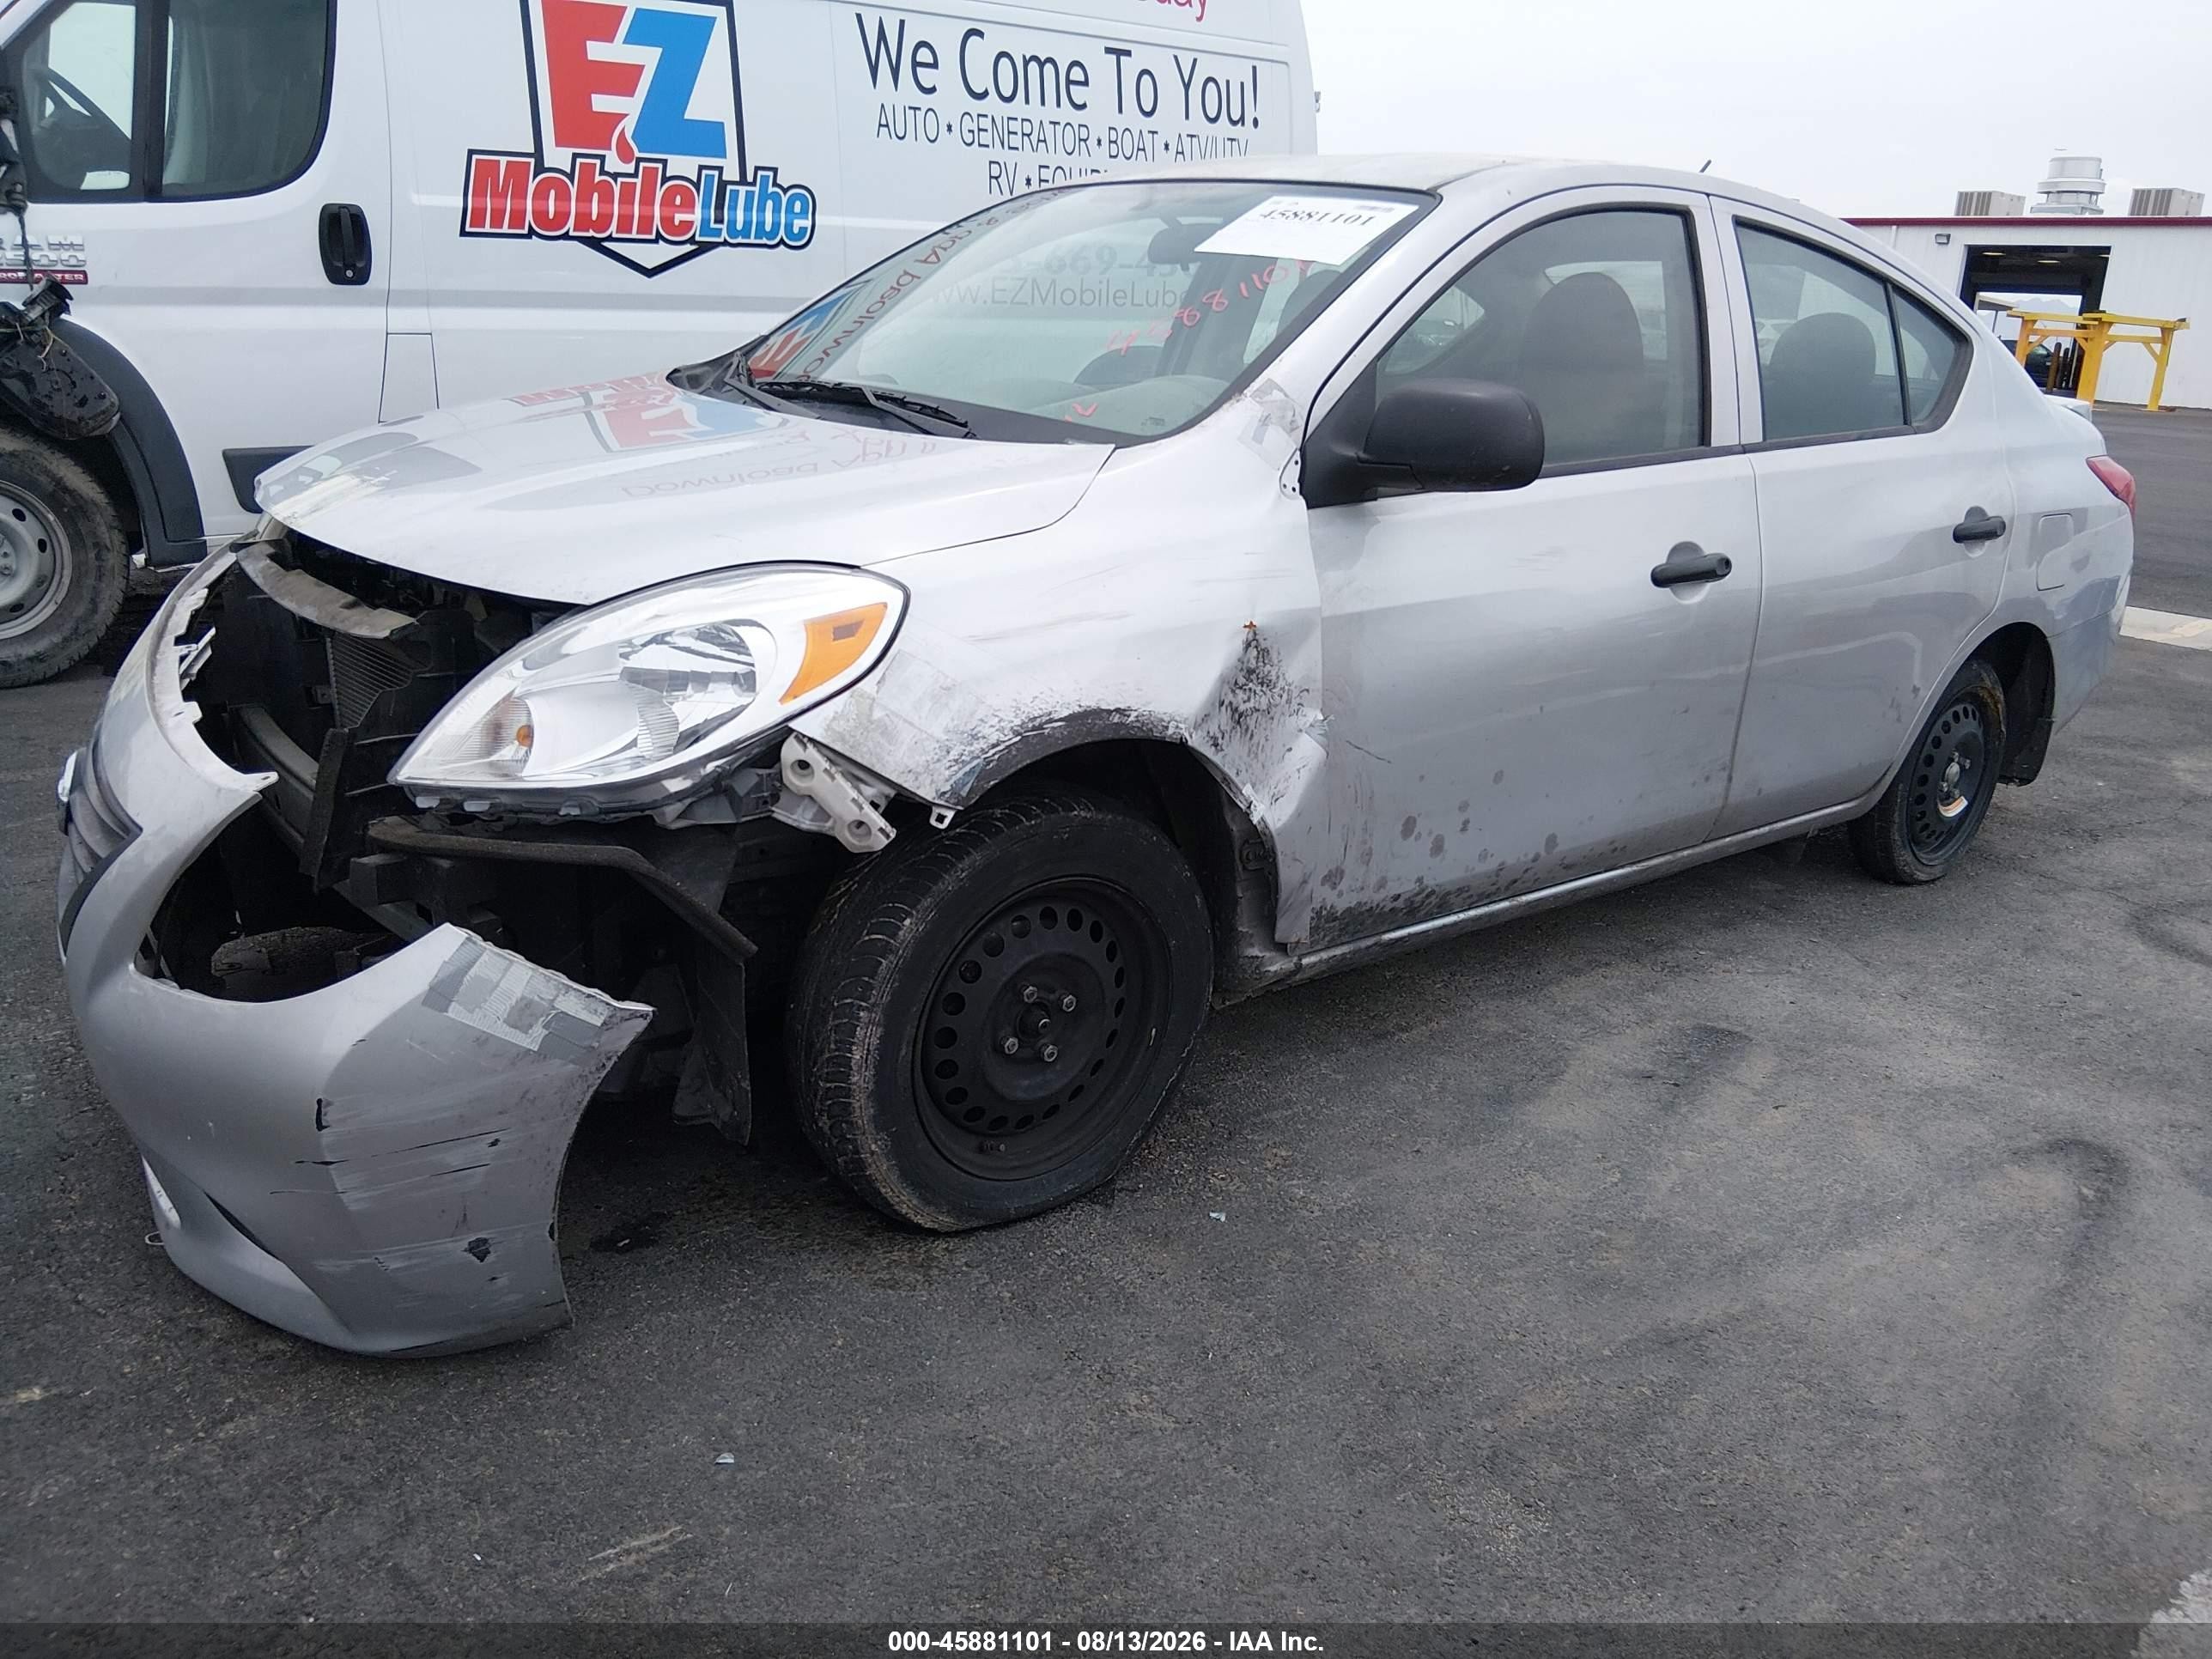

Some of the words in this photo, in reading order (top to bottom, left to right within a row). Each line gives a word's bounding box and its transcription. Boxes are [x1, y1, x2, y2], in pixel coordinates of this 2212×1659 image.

[541, 0, 727, 159] EZ
[855, 12, 940, 95] We
[958, 27, 1091, 112] Come
[1103, 46, 1159, 118] To
[1173, 53, 1261, 130] You!
[876, 102, 940, 144] AUTO
[959, 111, 1092, 158] GENERATOR
[1108, 126, 1159, 163] BOAT
[465, 156, 812, 244] MobileLube
[988, 160, 1018, 197] RV
[1260, 209, 1376, 227] 45881101
[0, 234, 85, 252] AM
[0, 251, 88, 268] 500
